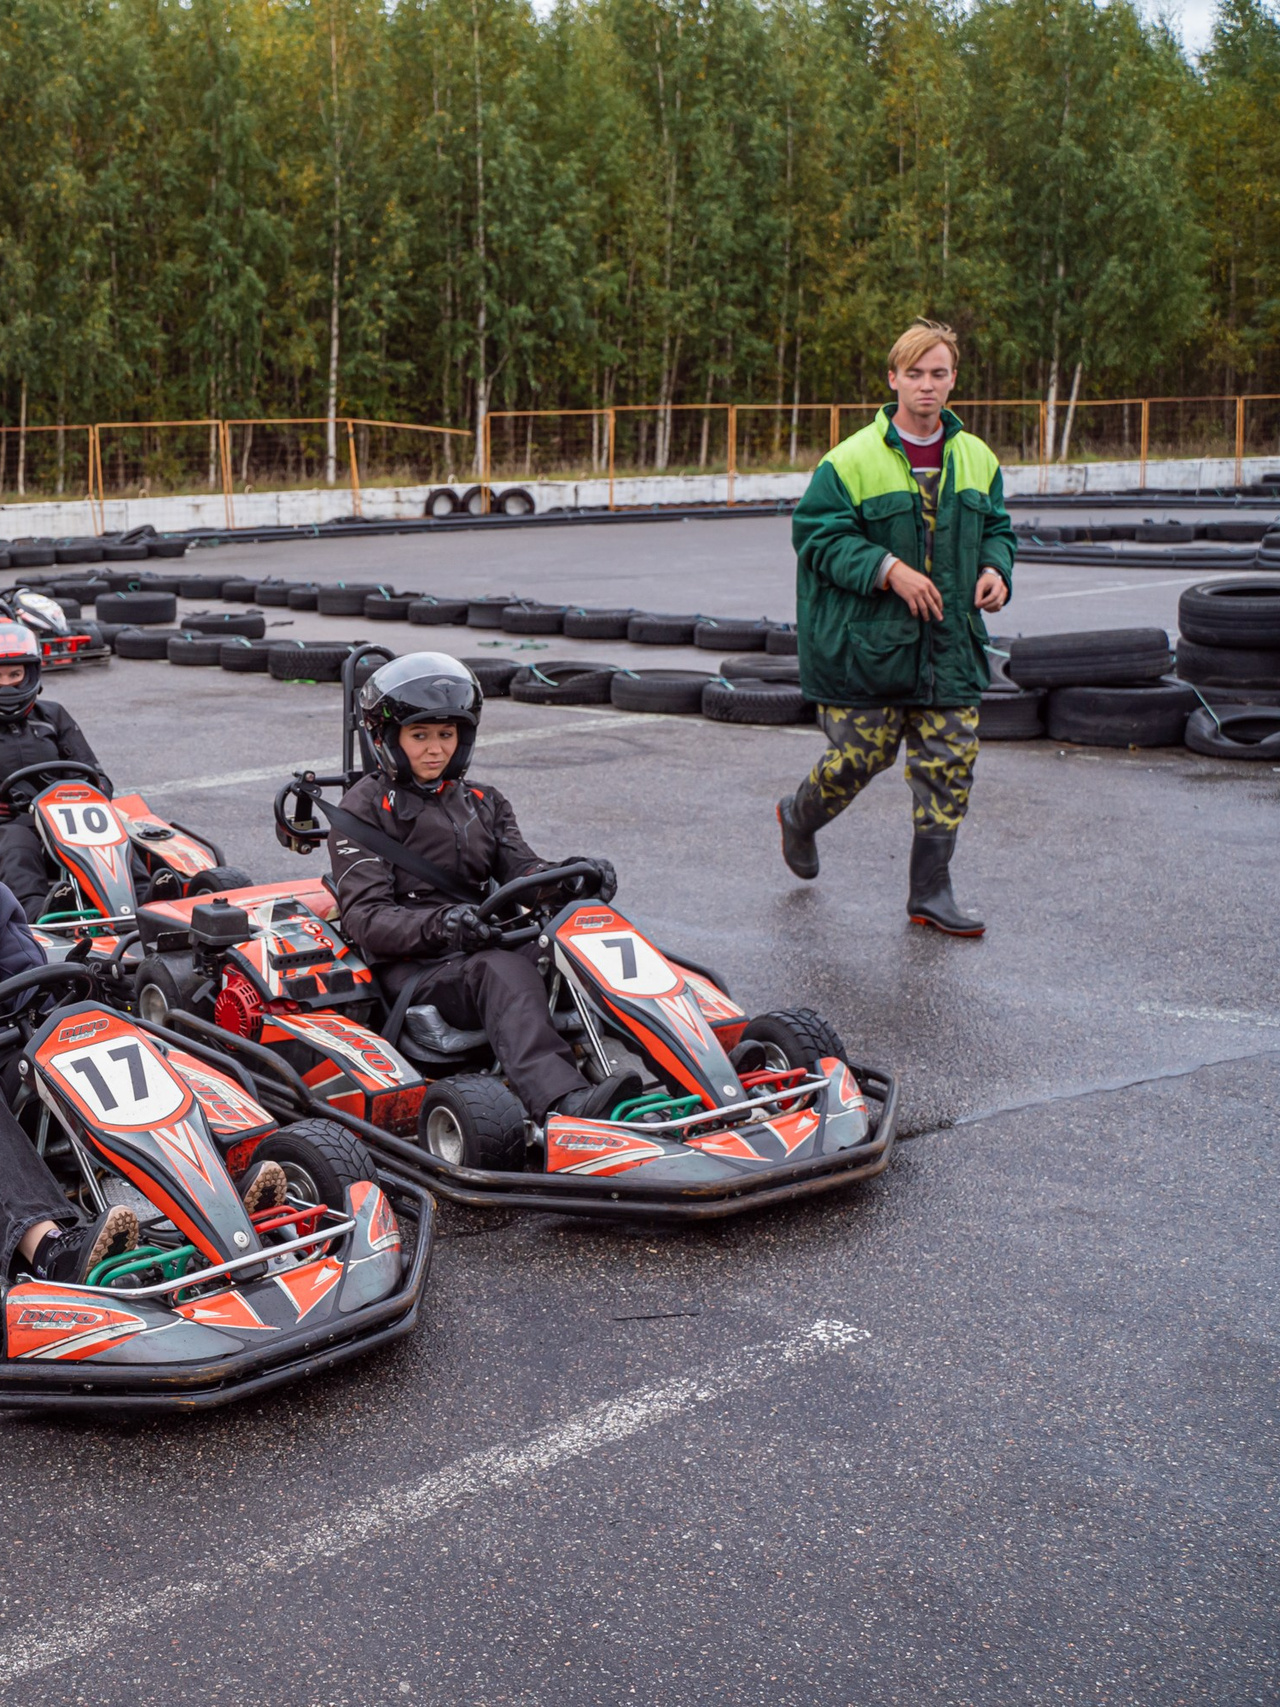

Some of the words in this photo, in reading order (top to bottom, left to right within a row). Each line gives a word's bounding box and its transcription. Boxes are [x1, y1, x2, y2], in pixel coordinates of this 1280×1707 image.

[58, 807, 109, 835] 10
[601, 938, 638, 980] 7
[59, 1019, 109, 1041] DINO
[305, 1019, 397, 1073] DINO
[70, 1043, 149, 1112] 17
[557, 1134, 625, 1148] DINO
[18, 1310, 100, 1324] DINO
